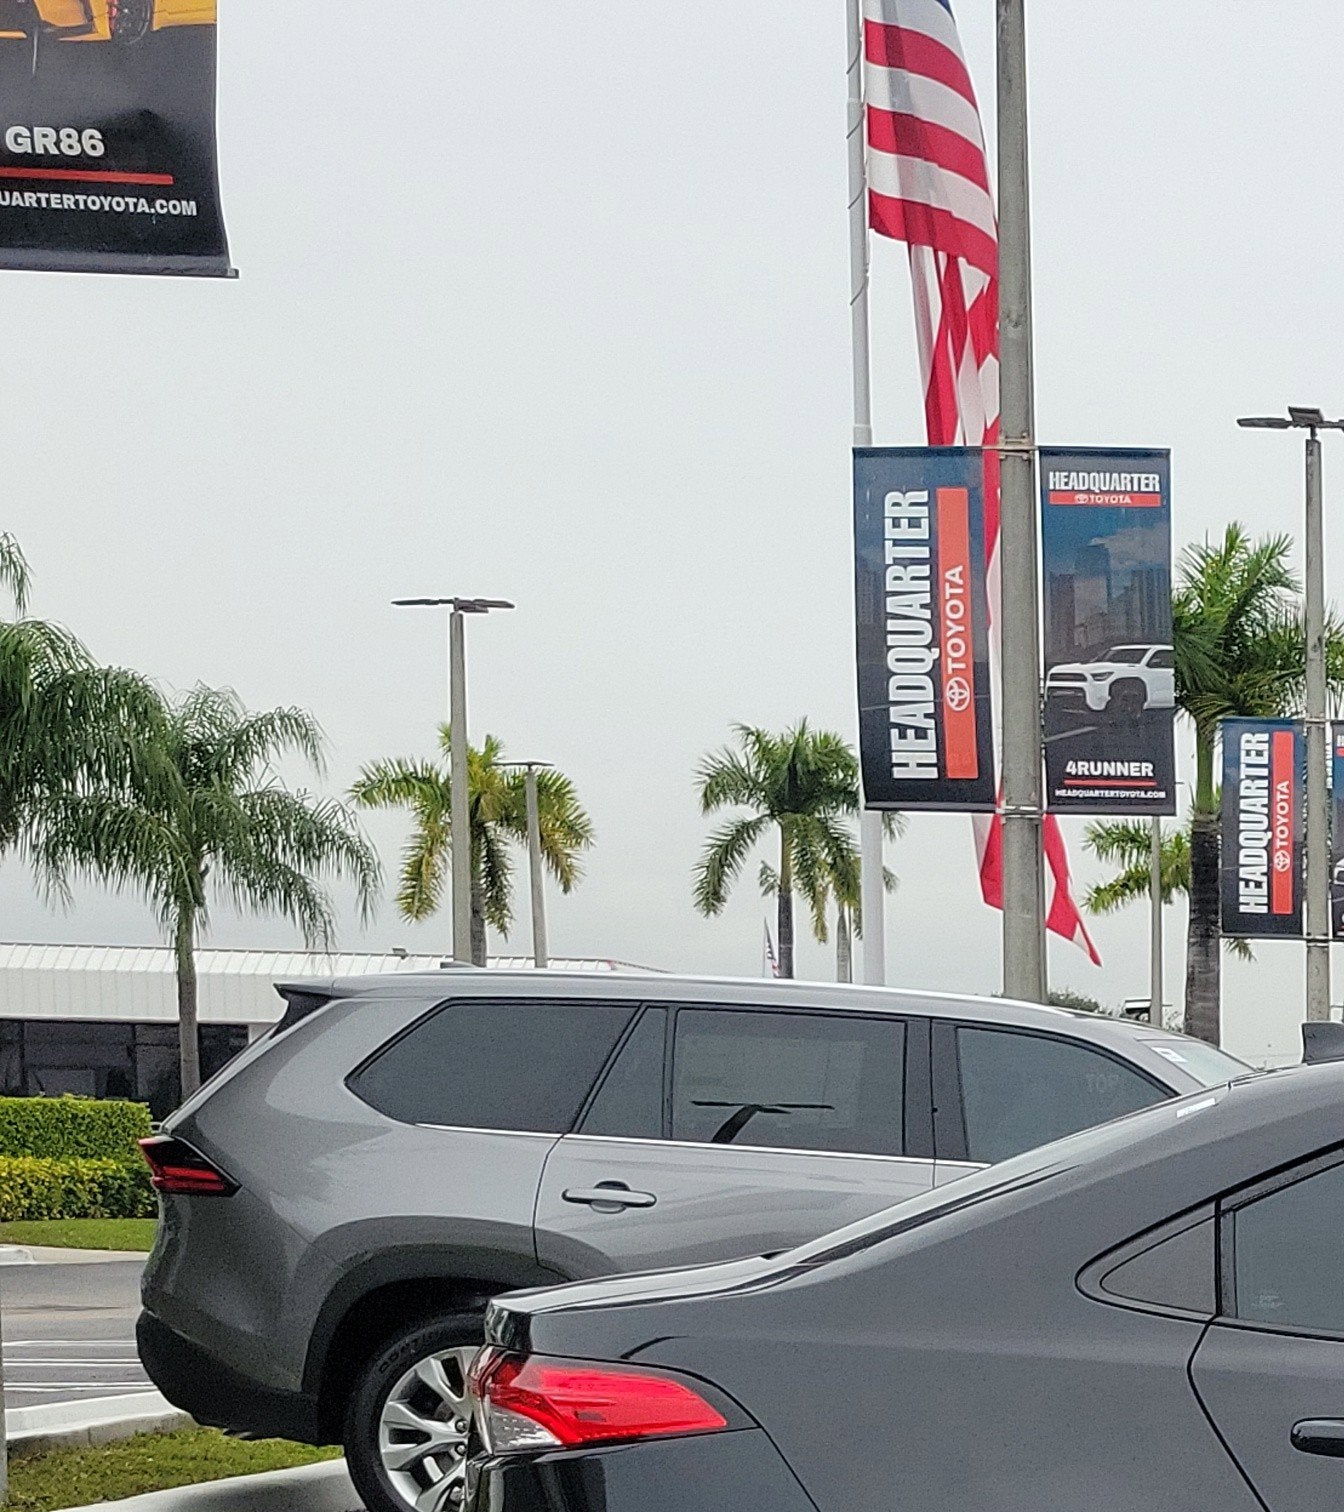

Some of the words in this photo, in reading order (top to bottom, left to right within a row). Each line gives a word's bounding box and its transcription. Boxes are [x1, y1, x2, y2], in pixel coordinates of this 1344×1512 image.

[5, 125, 105, 157] GR86
[1049, 471, 1160, 493] HEADQUARTER
[1090, 494, 1132, 504] TOYOTA
[884, 489, 940, 779] HEADQUARTER
[944, 565, 968, 674] TOYOTA
[1065, 760, 1154, 777] 4RUNNER
[1238, 732, 1272, 914] HEADQUARTER
[1275, 780, 1290, 849] TOYOTA
